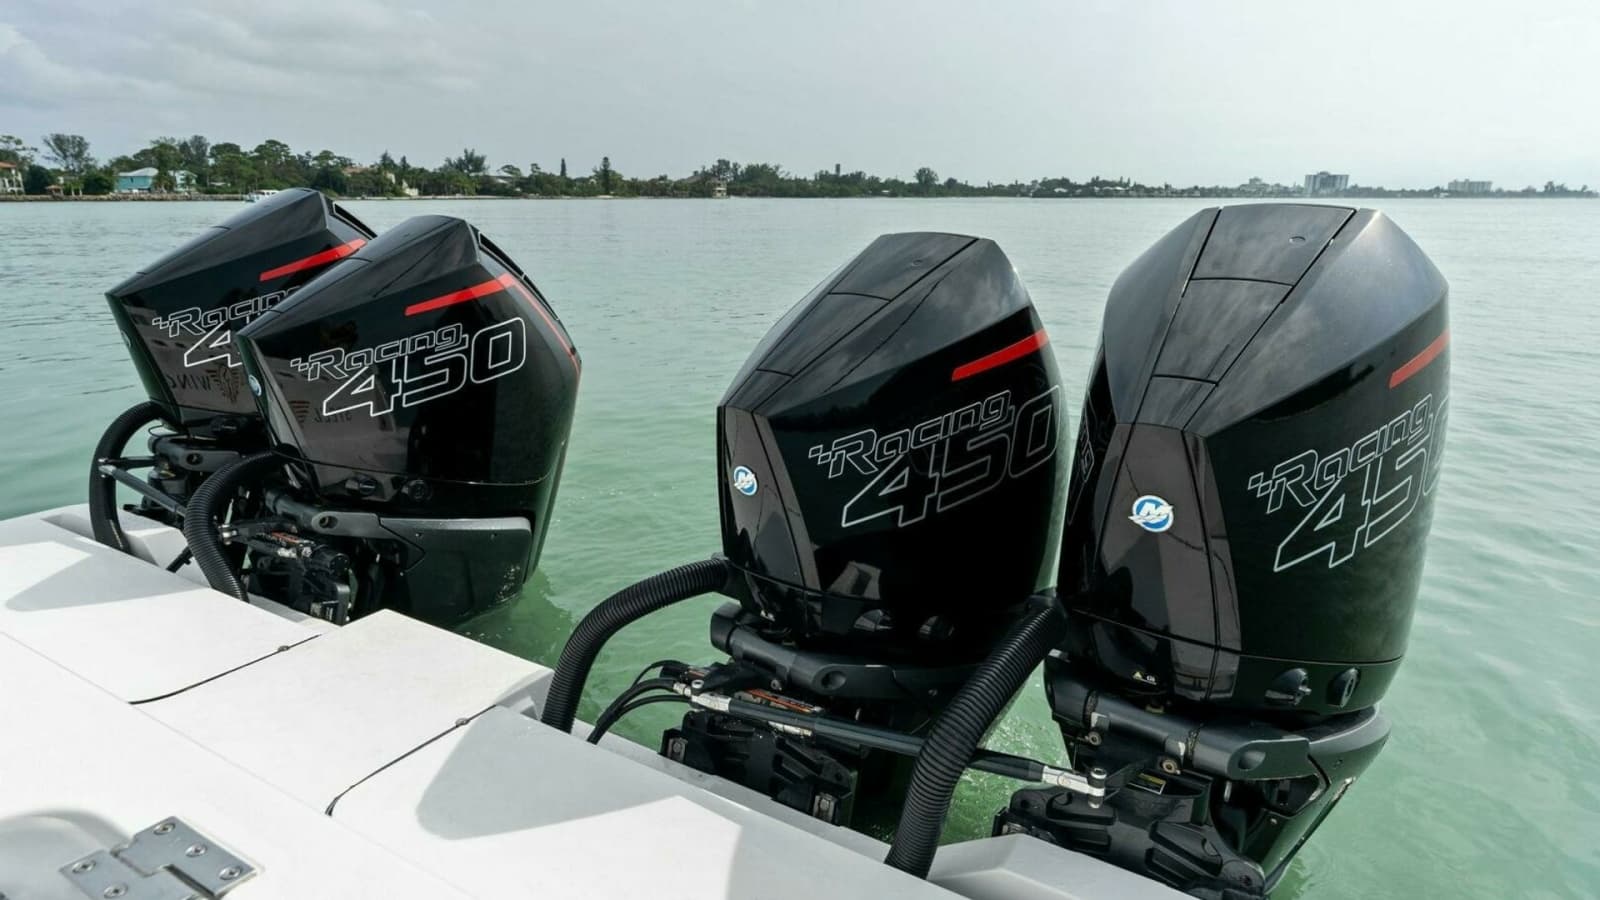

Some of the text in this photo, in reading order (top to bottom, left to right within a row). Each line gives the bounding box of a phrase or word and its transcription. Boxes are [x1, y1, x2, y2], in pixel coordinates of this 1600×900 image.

[167, 285, 302, 338] Racin
[306, 322, 464, 382] Racing
[323, 316, 526, 418] 450
[827, 389, 1012, 479] Racing
[841, 384, 1061, 528] 450
[1265, 393, 1433, 515] Racing
